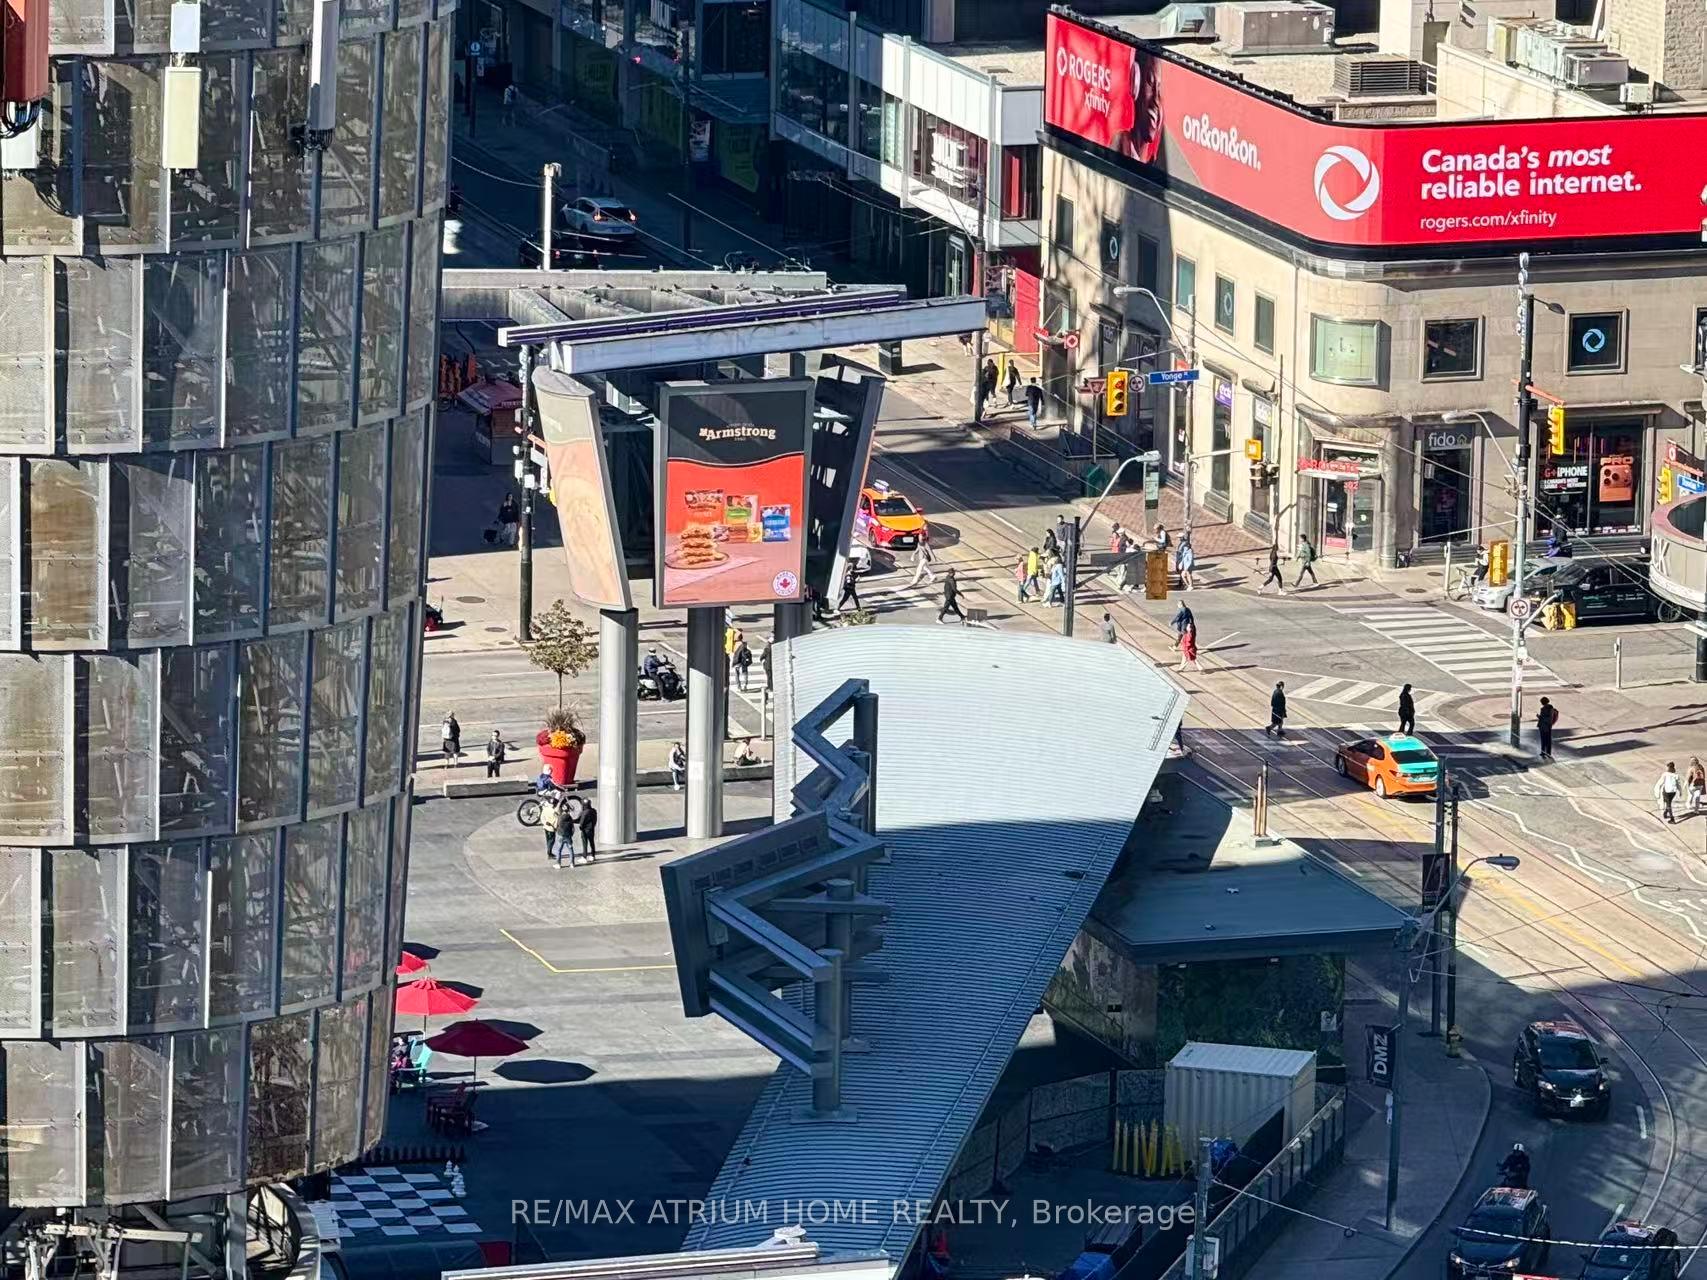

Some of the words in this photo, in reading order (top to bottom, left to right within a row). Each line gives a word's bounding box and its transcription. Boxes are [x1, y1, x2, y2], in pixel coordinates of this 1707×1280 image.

[1069, 53, 1111, 92] ROGERS
[1084, 88, 1111, 118] xfinity
[1183, 113, 1262, 171] on&on&on.
[1421, 144, 1540, 173] Canada's
[1548, 144, 1613, 168] most
[1420, 172, 1520, 200] reliable
[1529, 171, 1642, 196] internet.
[1420, 210, 1557, 233] rogers.com/xfinity
[1161, 372, 1183, 382] Yonge
[705, 426, 776, 440] Armstrong
[1428, 432, 1456, 447] fido
[1374, 1033, 1388, 1075] DMZ
